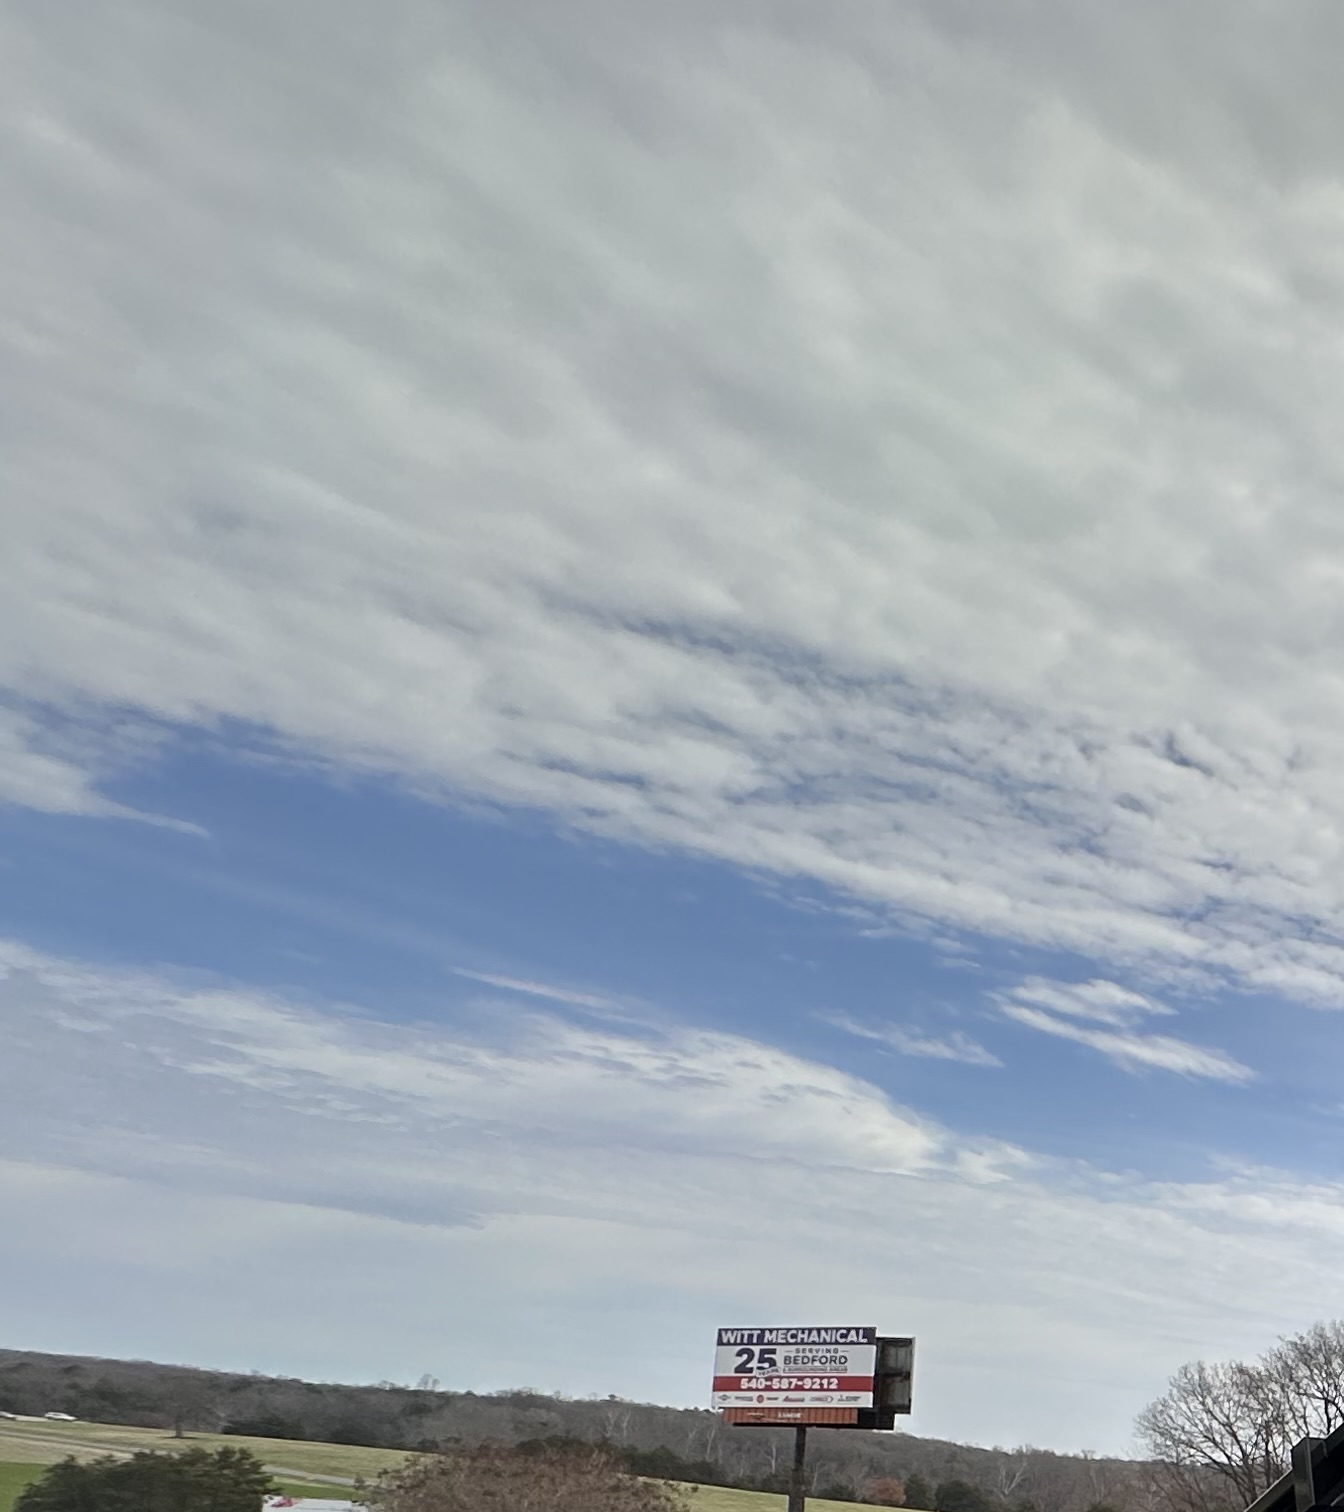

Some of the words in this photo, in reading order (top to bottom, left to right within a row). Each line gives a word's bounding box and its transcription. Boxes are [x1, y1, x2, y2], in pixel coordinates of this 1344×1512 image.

[721, 1331, 761, 1344] WITT
[765, 1329, 868, 1343] MECHANICAL
[734, 1348, 777, 1374] 25
[783, 1355, 848, 1365] BEDFORD
[740, 1377, 839, 1390] 540-587-9212
